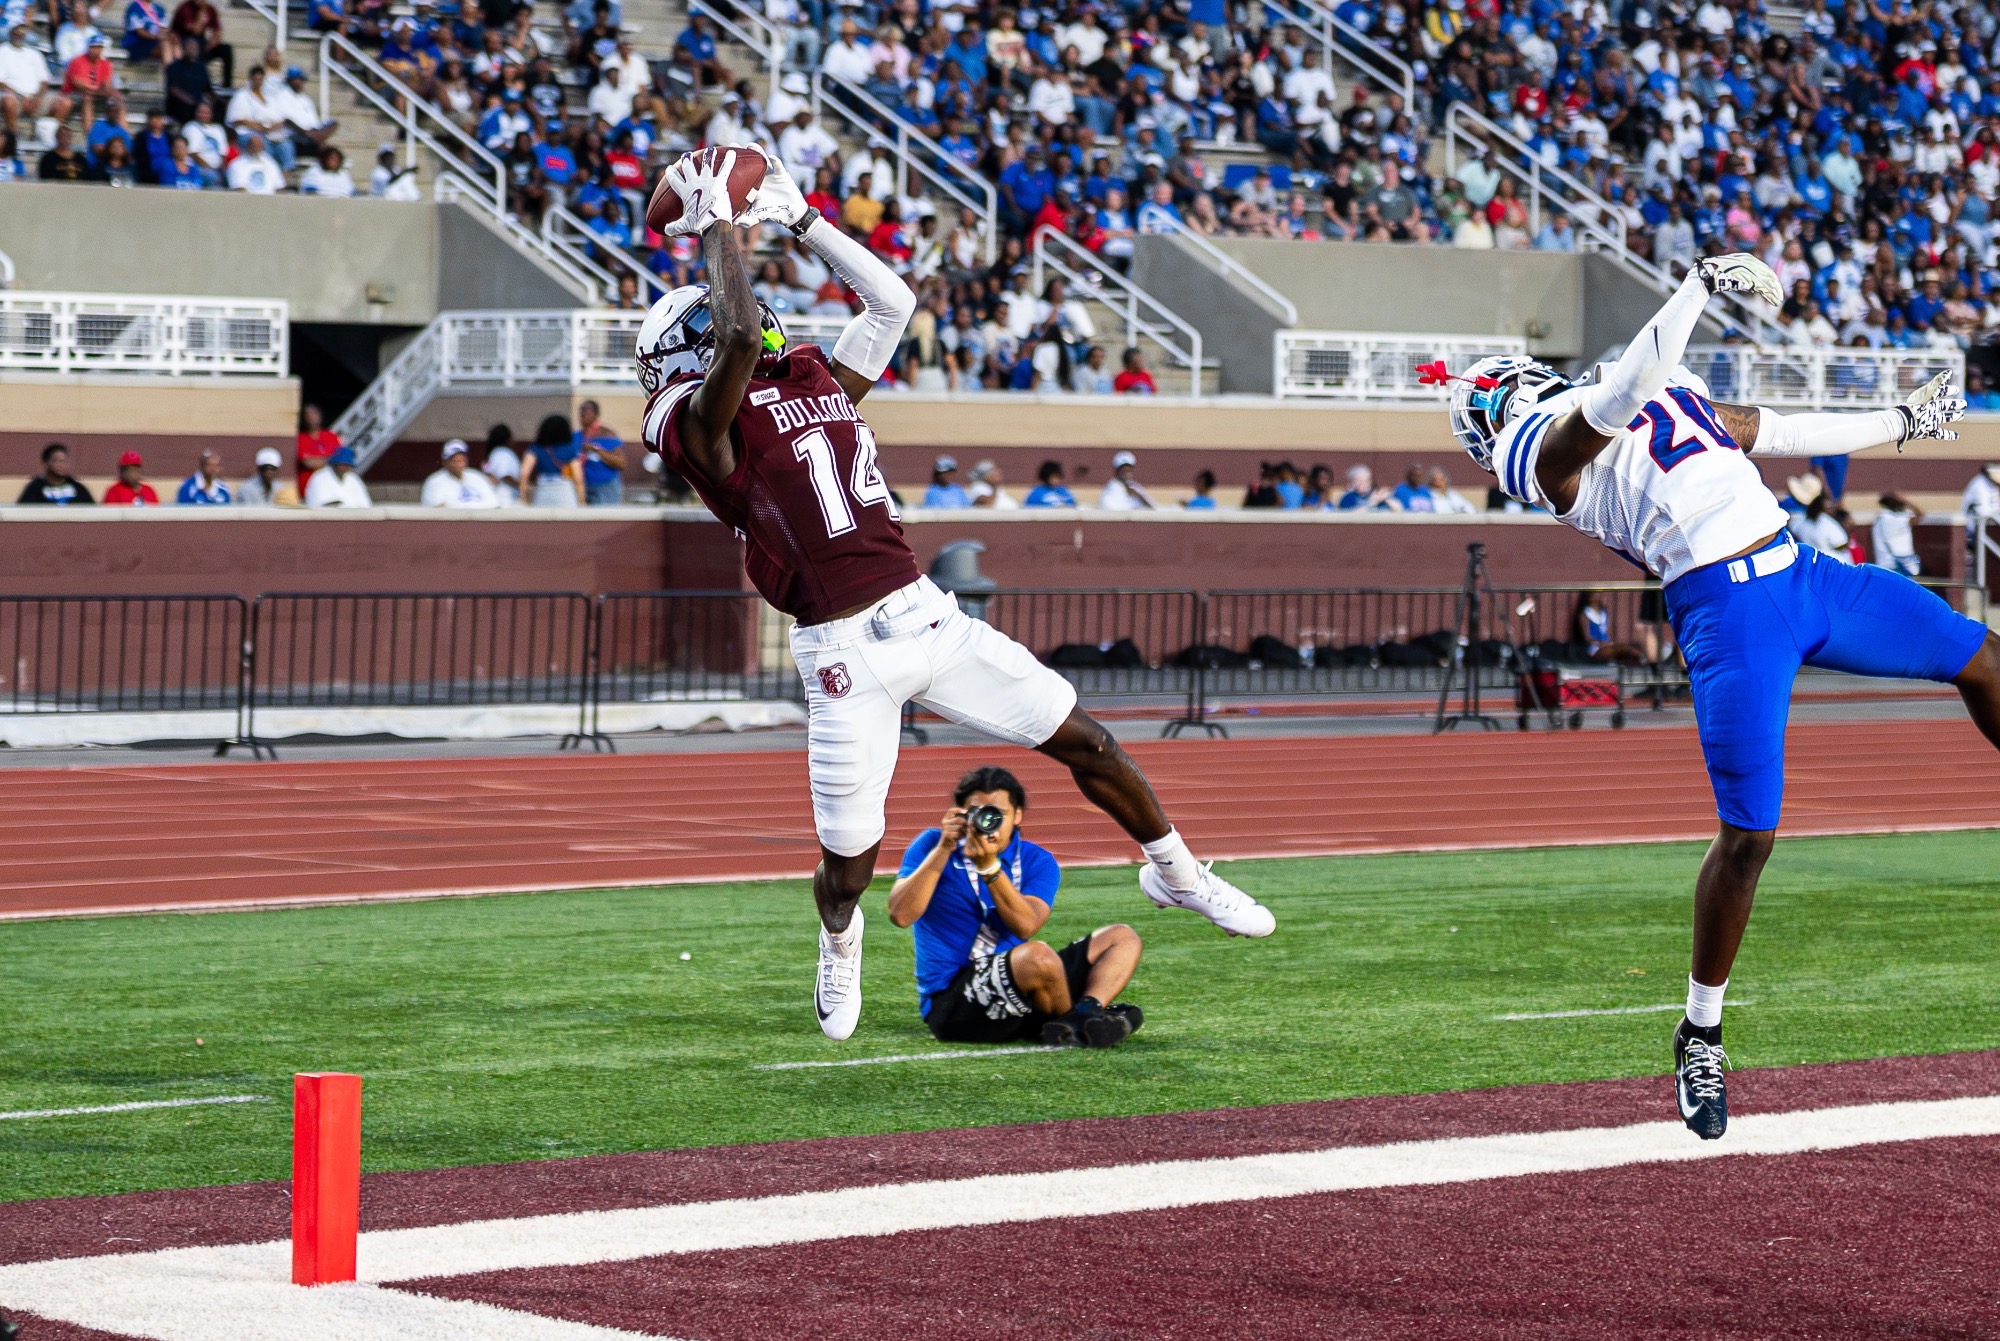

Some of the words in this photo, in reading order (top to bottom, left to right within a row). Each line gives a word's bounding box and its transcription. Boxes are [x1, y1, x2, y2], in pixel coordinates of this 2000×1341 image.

[760, 391, 776, 402] SWAC
[1626, 386, 1740, 474] 20
[791, 423, 901, 539] 14
